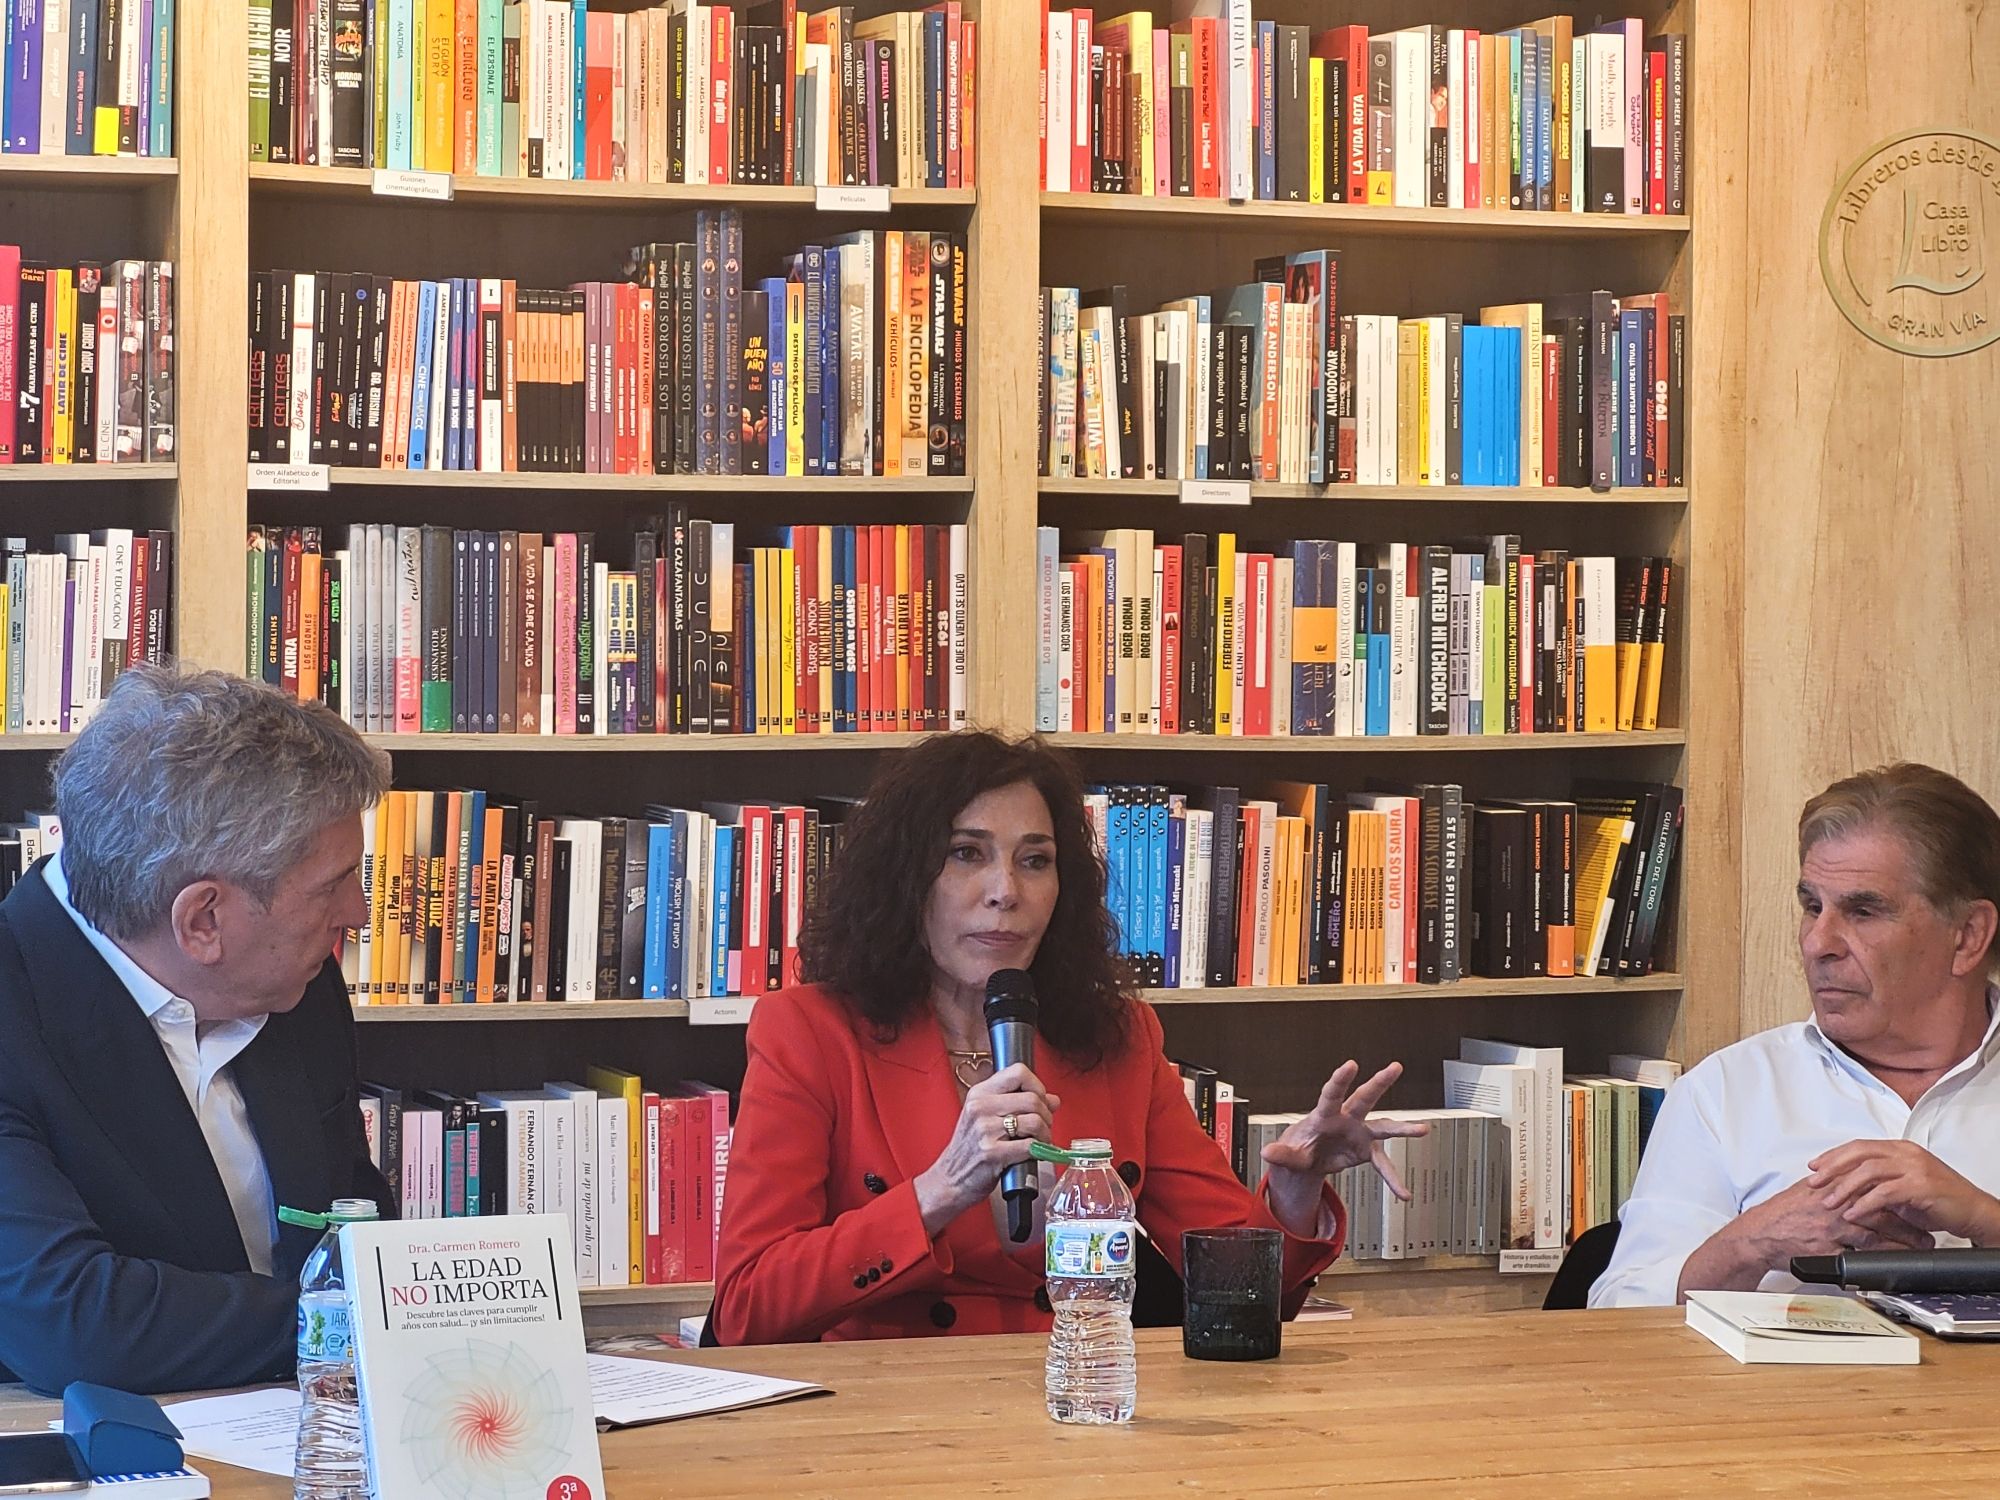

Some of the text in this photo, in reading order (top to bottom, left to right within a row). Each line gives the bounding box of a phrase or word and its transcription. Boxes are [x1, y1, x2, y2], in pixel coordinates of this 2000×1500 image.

[274, 29, 290, 62] NOIR
[432, 38, 440, 77] STORY
[488, 37, 494, 47] EL
[441, 49, 450, 77] GUIÓN
[1674, 85, 1681, 96] OF
[1353, 96, 1364, 174] LA VIDA ROTA
[1673, 131, 1681, 162] Charlie
[400, 175, 426, 183] Guiones
[1673, 164, 1681, 190] Sheen
[1839, 140, 1996, 225] Libreros desde
[1924, 202, 1969, 219] Casa
[1922, 235, 1970, 252] Libro
[1948, 222, 1970, 235] del
[850, 305, 863, 361] AVATAR
[889, 317, 899, 368] VEHÍCULOS
[1888, 315, 1944, 338] GRAN
[659, 292, 669, 410] LOS TESOROS DE
[909, 287, 922, 431] LA ENCICLOPEDIA
[1267, 301, 1278, 400] WES ANDERSON
[58, 333, 67, 414] LATIR DE CINE
[274, 354, 286, 426] CRITTERS
[793, 375, 798, 386] DE
[1325, 351, 1338, 416] ALMODÓVAR
[792, 388, 800, 426] PELÍCULA
[954, 372, 962, 420] ESCENARIOS
[1656, 381, 1667, 420] 1940
[101, 420, 110, 457] EL CINE
[256, 469, 276, 477] Orden
[273, 477, 300, 485] Editorial
[1202, 489, 1231, 497] Directores
[113, 576, 122, 629] EDUCACIÓN
[675, 548, 683, 630] CAZAFANTASMAS
[956, 599, 964, 608] SE
[899, 595, 908, 656] TAXI DRIVER
[938, 611, 948, 647] 1938
[956, 611, 964, 636] VIENTO
[1061, 582, 1070, 651] LOS HERMANOS COEN
[1123, 597, 1132, 658] ROGER CORMAN
[1223, 597, 1232, 669] FEDERICO FELLINI
[956, 638, 964, 646] EL
[956, 650, 964, 663] QUE
[1431, 567, 1447, 712] ALFRED HITCHCOCK
[285, 638, 297, 678] AKIRA
[956, 666, 964, 674] LO
[1165, 635, 1175, 711] Cameron Crowe
[807, 820, 816, 872] MICHAEL
[1390, 808, 1401, 909] CARLOS SAURA
[1424, 807, 1439, 910] MARTIN SCORSESE
[1646, 812, 1672, 910] GUILLERMO DEL TORO
[483, 860, 497, 927] LA PLANTA BAJA
[1445, 817, 1456, 949] STEVEN SPIELBERG
[1261, 893, 1269, 922] PAOLO
[1260, 924, 1268, 944] PIER
[519, 1111, 525, 1120] EL
[527, 1164, 536, 1200] FERNÁN
[583, 1178, 593, 1190] de
[584, 1193, 593, 1220] queda
[408, 1240, 520, 1254] Dra. Carmen Romero
[583, 1224, 593, 1241] que
[582, 1245, 591, 1257] Lo
[412, 1257, 522, 1282] LA EDAD
[390, 1279, 549, 1305] NO IMPORTA
[401, 1321, 420, 1330] años
[479, 1317, 491, 1325] sin
[493, 1314, 545, 1325] limitaciones!
[406, 1305, 538, 1320] Descubre las claves para cumplir
